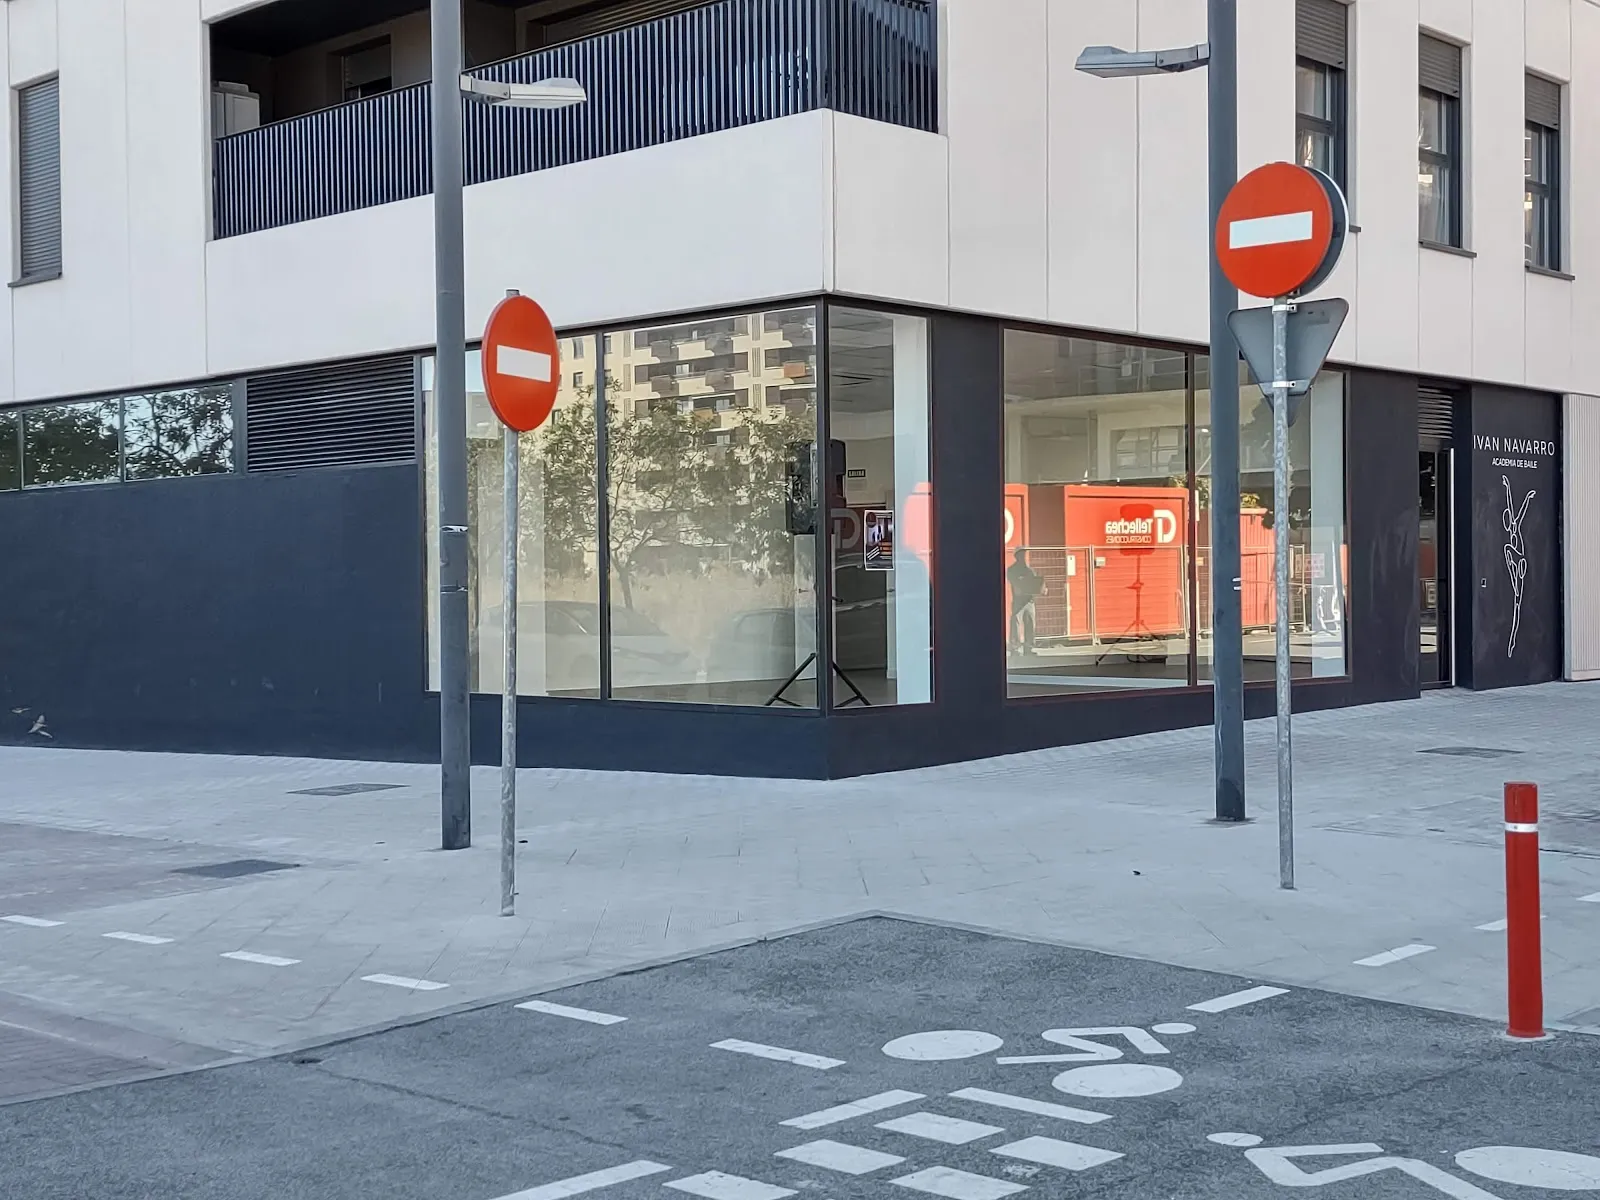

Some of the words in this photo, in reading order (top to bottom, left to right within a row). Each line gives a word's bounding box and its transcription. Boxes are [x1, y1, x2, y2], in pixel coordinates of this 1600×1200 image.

[1473, 435, 1499, 451] IVAN
[1504, 437, 1555, 456] NAVARRO
[1492, 458, 1516, 467] ACADEMIA
[1517, 459, 1523, 468] DE
[1524, 460, 1537, 468] BAILE
